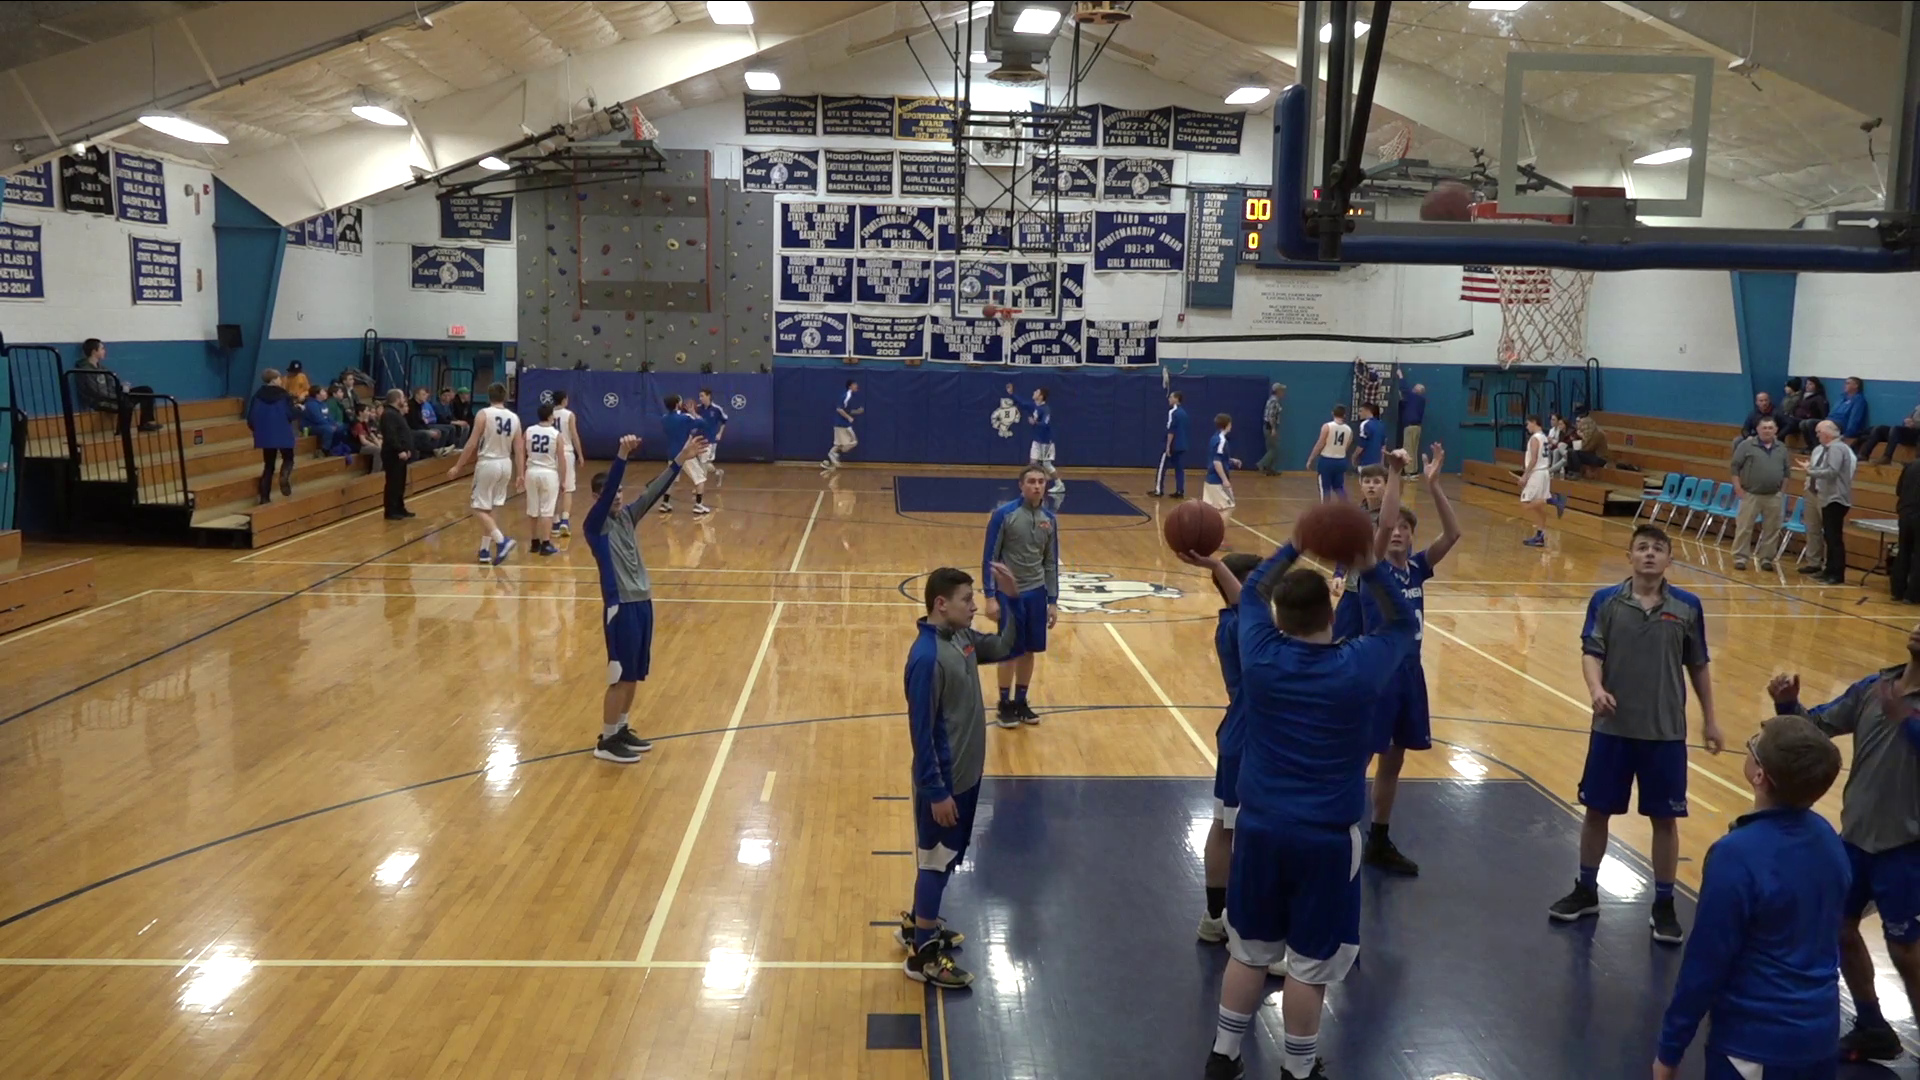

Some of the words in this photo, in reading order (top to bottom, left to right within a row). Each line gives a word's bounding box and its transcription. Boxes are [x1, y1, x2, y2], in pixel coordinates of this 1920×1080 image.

[827, 110, 850, 118] STATE
[852, 111, 890, 119] CHAMPIONS
[1178, 127, 1210, 135] EASTERN
[1177, 135, 1238, 144] CHAMPIONS
[746, 168, 766, 176] EAST
[920, 165, 935, 173] STATE
[831, 173, 853, 181] GIRLS
[855, 174, 880, 182] CLASS
[828, 183, 871, 191] BASKETBALL
[903, 184, 945, 192] BASKETBALL
[122, 194, 162, 209] BASKETBALL
[1246, 198, 1271, 220] 00
[472, 213, 491, 221] CLASS
[788, 212, 805, 221] STATE
[812, 213, 849, 223] CHAMPIONS
[1113, 214, 1139, 224] IAABO
[458, 221, 494, 229] BASKETBALL
[815, 221, 835, 231] CLASS
[839, 222, 844, 232] C
[861, 215, 912, 238] SPORTSMANSHIP
[913, 219, 934, 240] AWARD
[973, 225, 993, 235] CLASS
[799, 230, 837, 240] BASKETBALL
[962, 233, 988, 244] SOCCER
[1027, 233, 1044, 243] BOYS
[1097, 226, 1155, 251] SPORTSMANSHIP
[1158, 232, 1183, 252] AWARD
[890, 239, 928, 250] BASKETBALL
[1200, 238, 1234, 246] FITZPATRICK
[1248, 232, 1259, 249] 0
[4, 253, 25, 265] CLASS
[1107, 258, 1125, 268] GIRLS
[1130, 258, 1171, 268] BASKETBALL
[418, 268, 438, 276] EAST
[787, 265, 806, 275] STATE
[813, 266, 847, 276] CHAMPIONS
[139, 276, 176, 287] BASKETBALL
[811, 275, 830, 285] CLASS
[837, 276, 843, 286] C
[798, 284, 835, 294] BASKETBALL
[874, 285, 911, 295] BASKETBALL
[1062, 277, 1084, 297] AWARD
[778, 317, 793, 330] GOOD
[794, 313, 844, 330] SPORTSMANSHIP
[780, 333, 796, 341] EAST
[963, 335, 982, 344] CLASS
[1062, 333, 1081, 352] AWARD
[1119, 338, 1137, 348] CLASS
[948, 343, 985, 353] BASKETBALL
[1119, 347, 1145, 356] COUNTRY
[1041, 355, 1077, 364] BASKETBALL
[495, 416, 512, 437] 34
[1333, 430, 1345, 446] 14
[531, 434, 550, 454] 22
